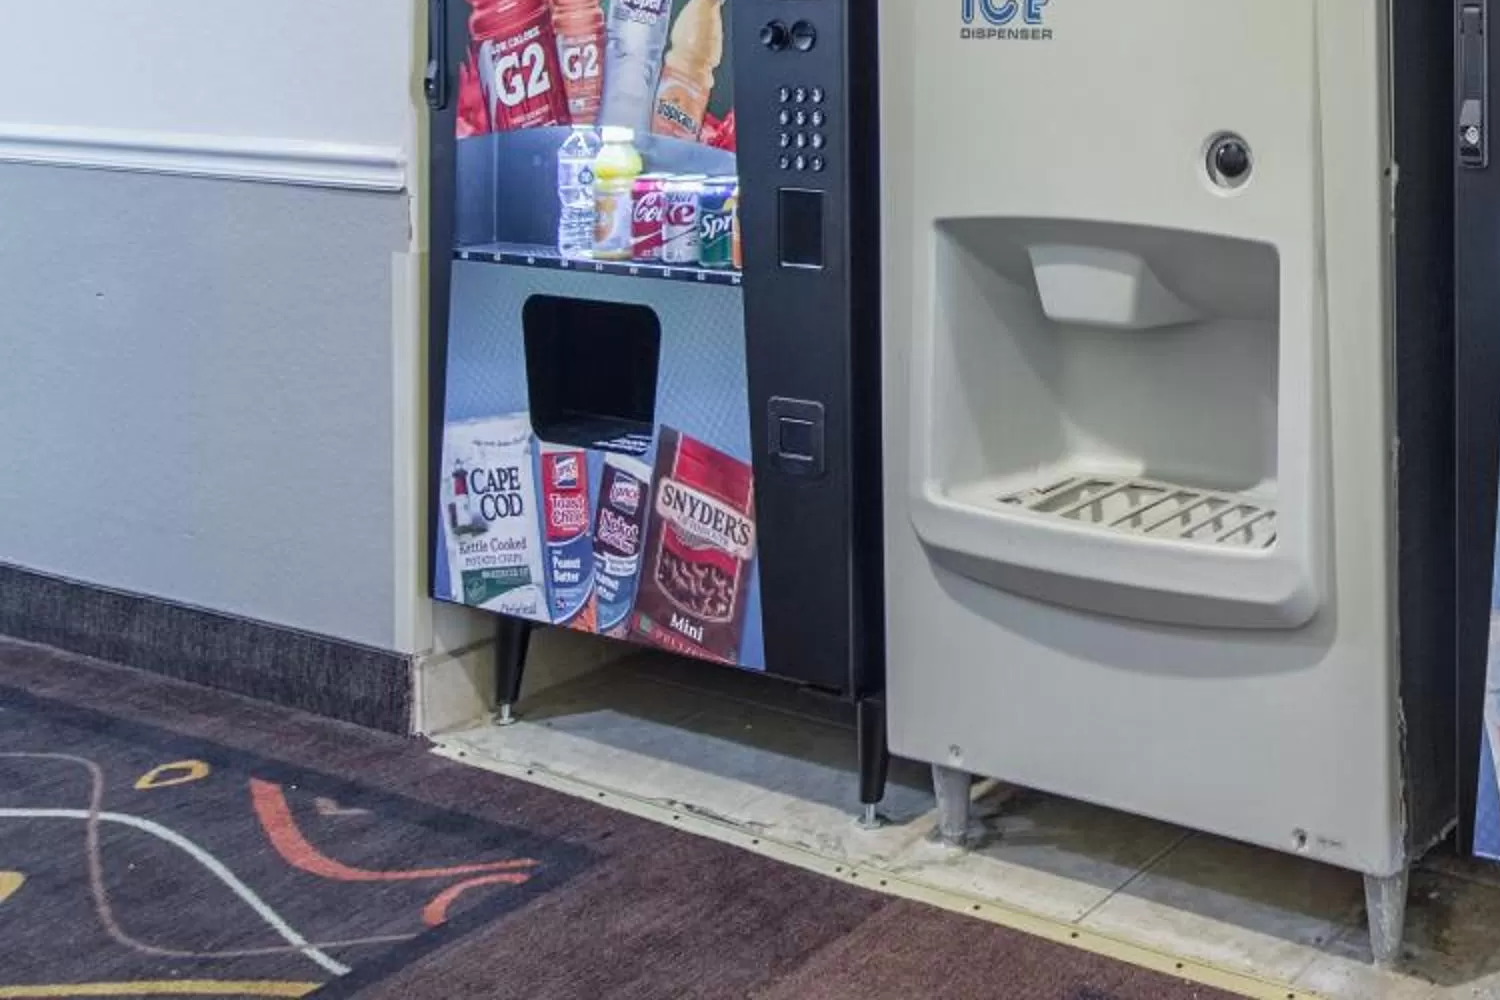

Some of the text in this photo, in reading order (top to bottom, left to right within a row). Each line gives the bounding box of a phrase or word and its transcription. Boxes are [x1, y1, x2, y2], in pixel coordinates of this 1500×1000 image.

[960, 27, 1053, 40] DISPENSER
[495, 42, 551, 107] G2
[564, 43, 599, 80] G2
[699, 214, 733, 238] Spr
[470, 466, 521, 495] CAPE
[481, 493, 523, 521] COD
[662, 483, 751, 546] SNYDER'S
[669, 611, 704, 642] Mini
